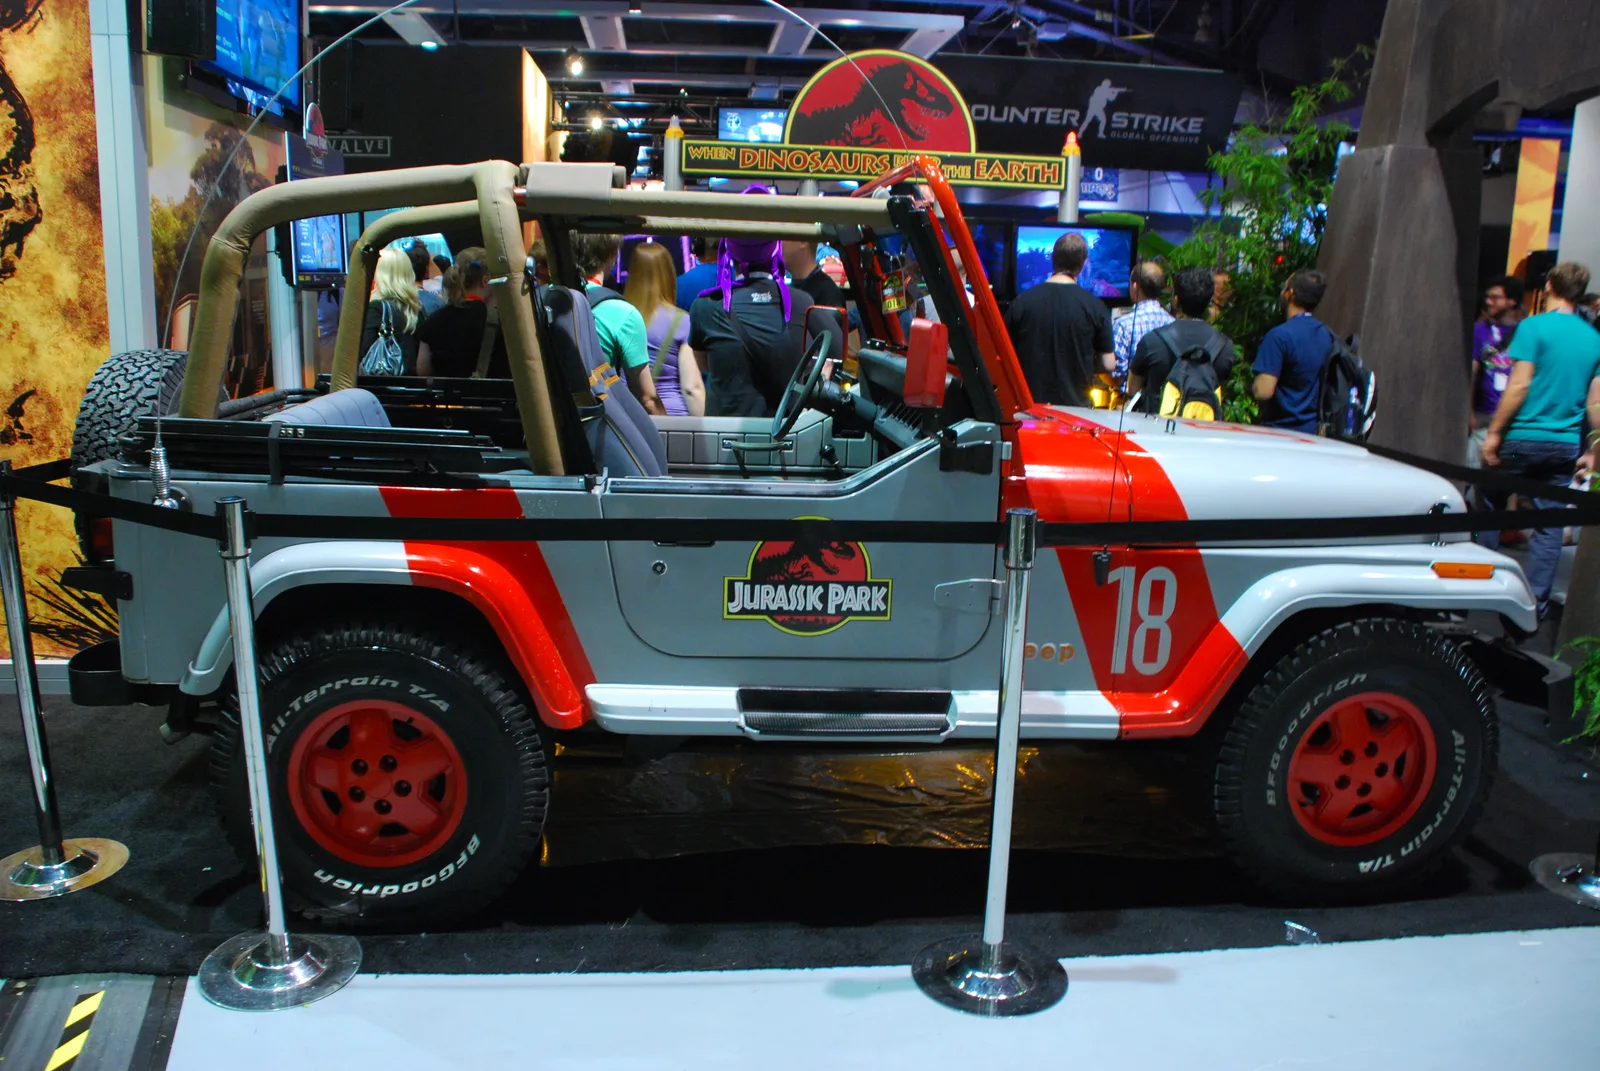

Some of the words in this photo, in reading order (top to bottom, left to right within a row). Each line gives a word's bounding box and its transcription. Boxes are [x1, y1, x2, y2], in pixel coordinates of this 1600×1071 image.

[968, 104, 1081, 127] OUNTER
[1111, 111, 1204, 133] STRIKE
[1110, 130, 1146, 141] GLOBAL
[1149, 133, 1200, 144] OFFENSIVE
[688, 146, 737, 160] WHEN
[739, 148, 891, 174] DINOSAURS
[943, 164, 971, 179] THE
[974, 159, 1060, 183] EARTH
[728, 582, 824, 613] JURASSIC
[827, 583, 888, 614] PARK
[1107, 566, 1178, 676] 18
[1024, 642, 1076, 663] eep
[267, 675, 400, 754] All-Terrain
[408, 683, 450, 713] T/A
[1267, 673, 1367, 806] BFGoodrich
[1401, 729, 1466, 857] All-Terrain
[313, 833, 481, 898] BFGoodrich
[1358, 854, 1395, 873] T/A
